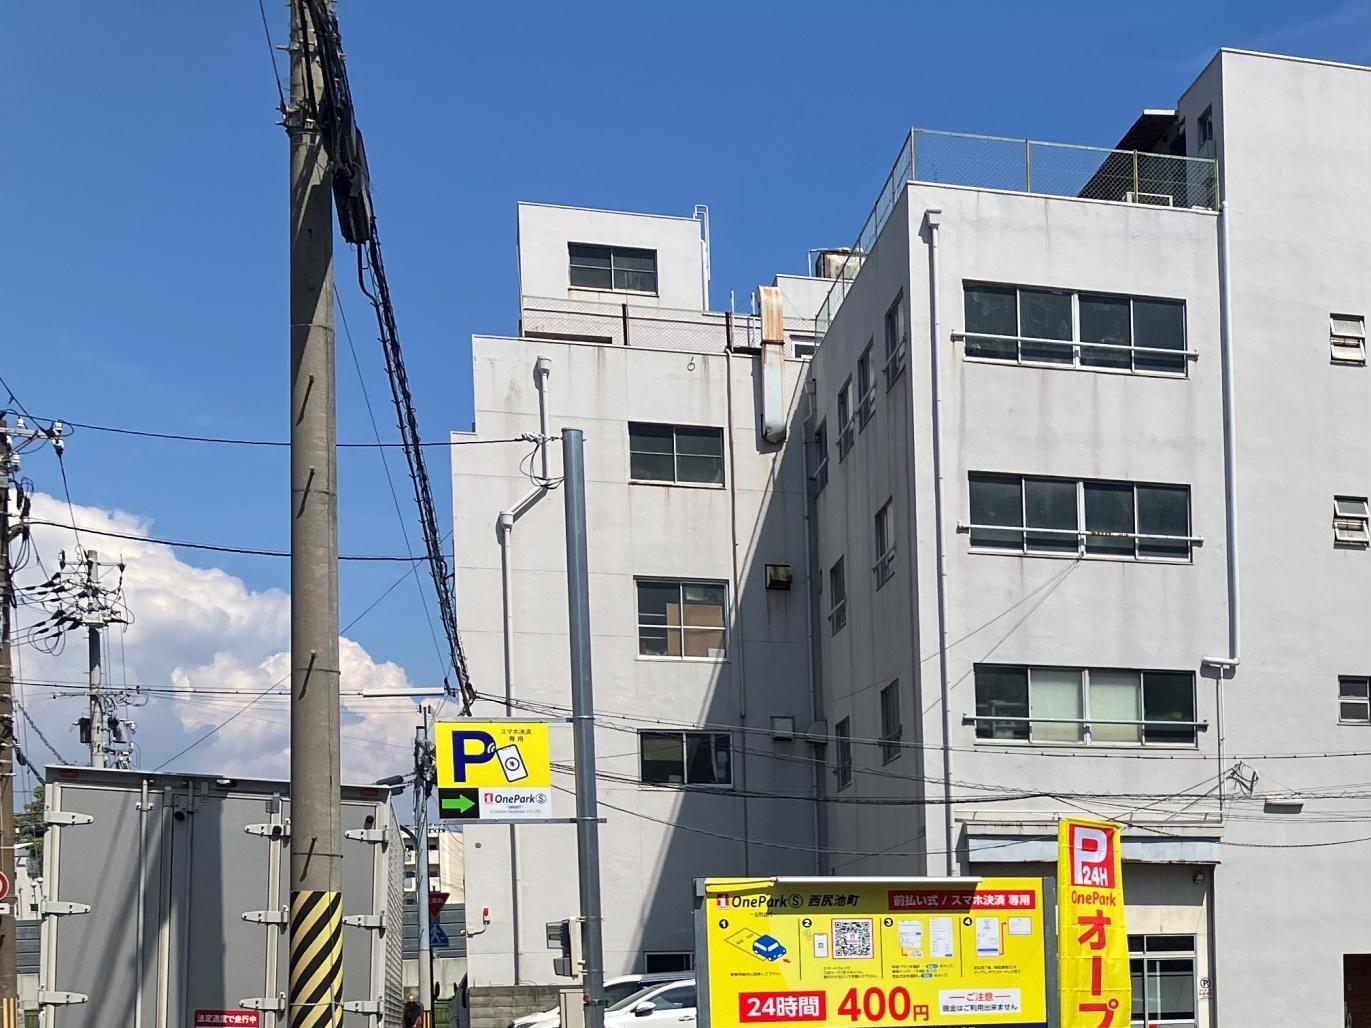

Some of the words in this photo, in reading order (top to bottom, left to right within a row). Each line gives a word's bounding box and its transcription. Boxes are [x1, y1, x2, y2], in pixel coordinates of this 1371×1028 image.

[452, 730, 496, 782] P
[1074, 827, 1107, 884] P
[1082, 865, 1108, 887] 24H
[731, 895, 788, 908] OnePark
[808, 894, 860, 907] 西尻池町
[894, 895, 939, 906] 前払い式
[951, 894, 1006, 906] スマホ決済
[1008, 894, 1031, 906] 専用
[1071, 890, 1117, 907] OnePark
[966, 993, 994, 1001] ご注意
[747, 995, 820, 1017] 24時間
[942, 1004, 1018, 1012] 現金はご利用出来ません
